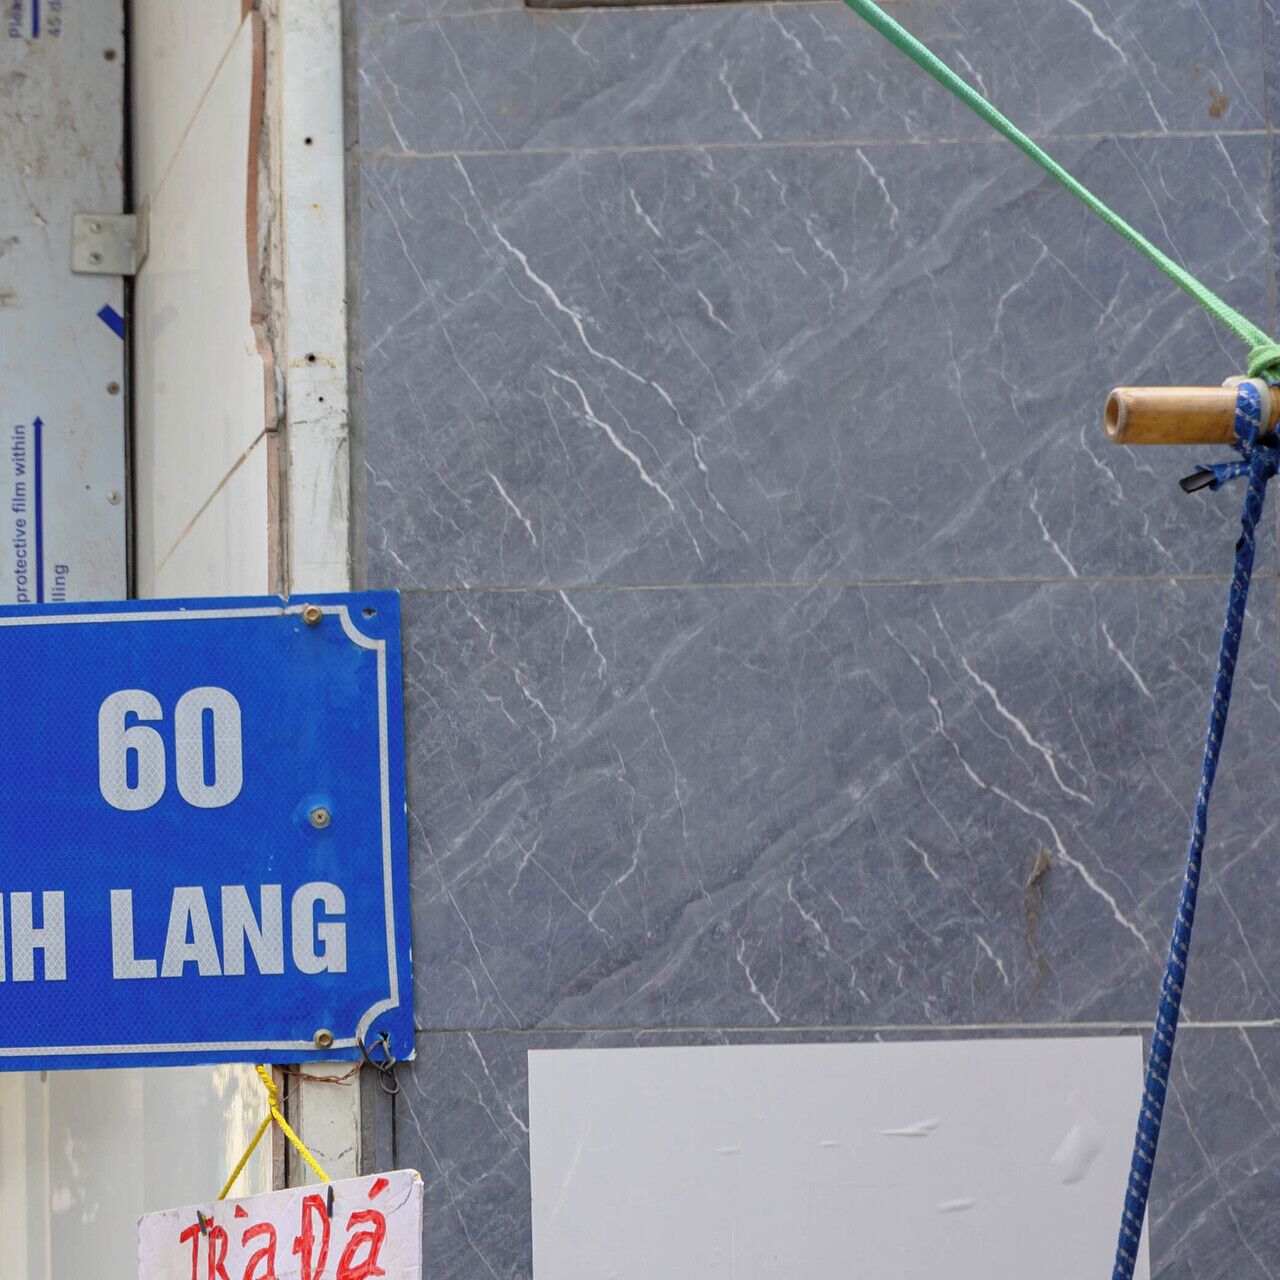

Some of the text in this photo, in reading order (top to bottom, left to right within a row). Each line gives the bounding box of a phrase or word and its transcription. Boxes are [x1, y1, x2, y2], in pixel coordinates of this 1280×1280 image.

[11, 424, 30, 603] protective film within
[97, 685, 244, 812] 60
[111, 881, 348, 980] LANG
